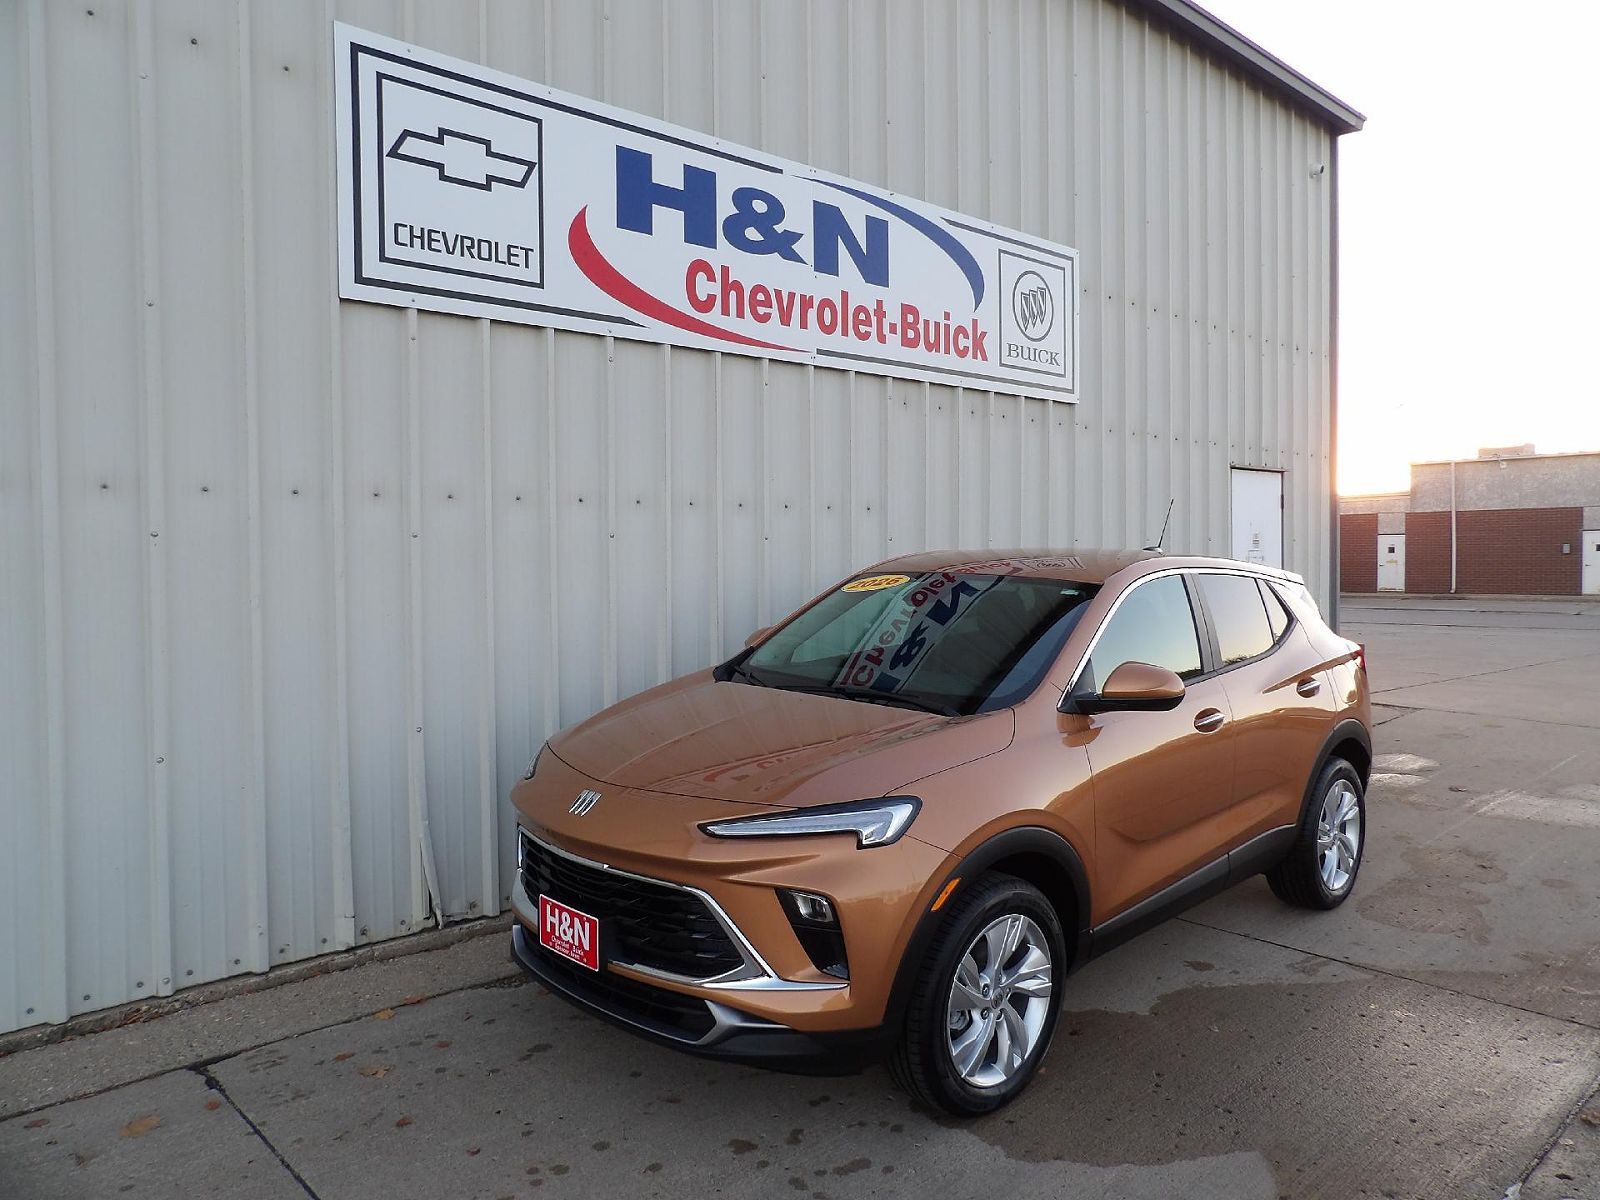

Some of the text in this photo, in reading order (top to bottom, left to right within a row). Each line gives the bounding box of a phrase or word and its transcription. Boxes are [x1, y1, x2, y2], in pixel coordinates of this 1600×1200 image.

[616, 144, 889, 288] H&N
[394, 222, 534, 269] CHEVROLET
[686, 259, 988, 362] Chevrolet-Buick
[1006, 342, 1060, 367] BUICK
[847, 576, 904, 590] 2026
[546, 903, 590, 951] H&N
